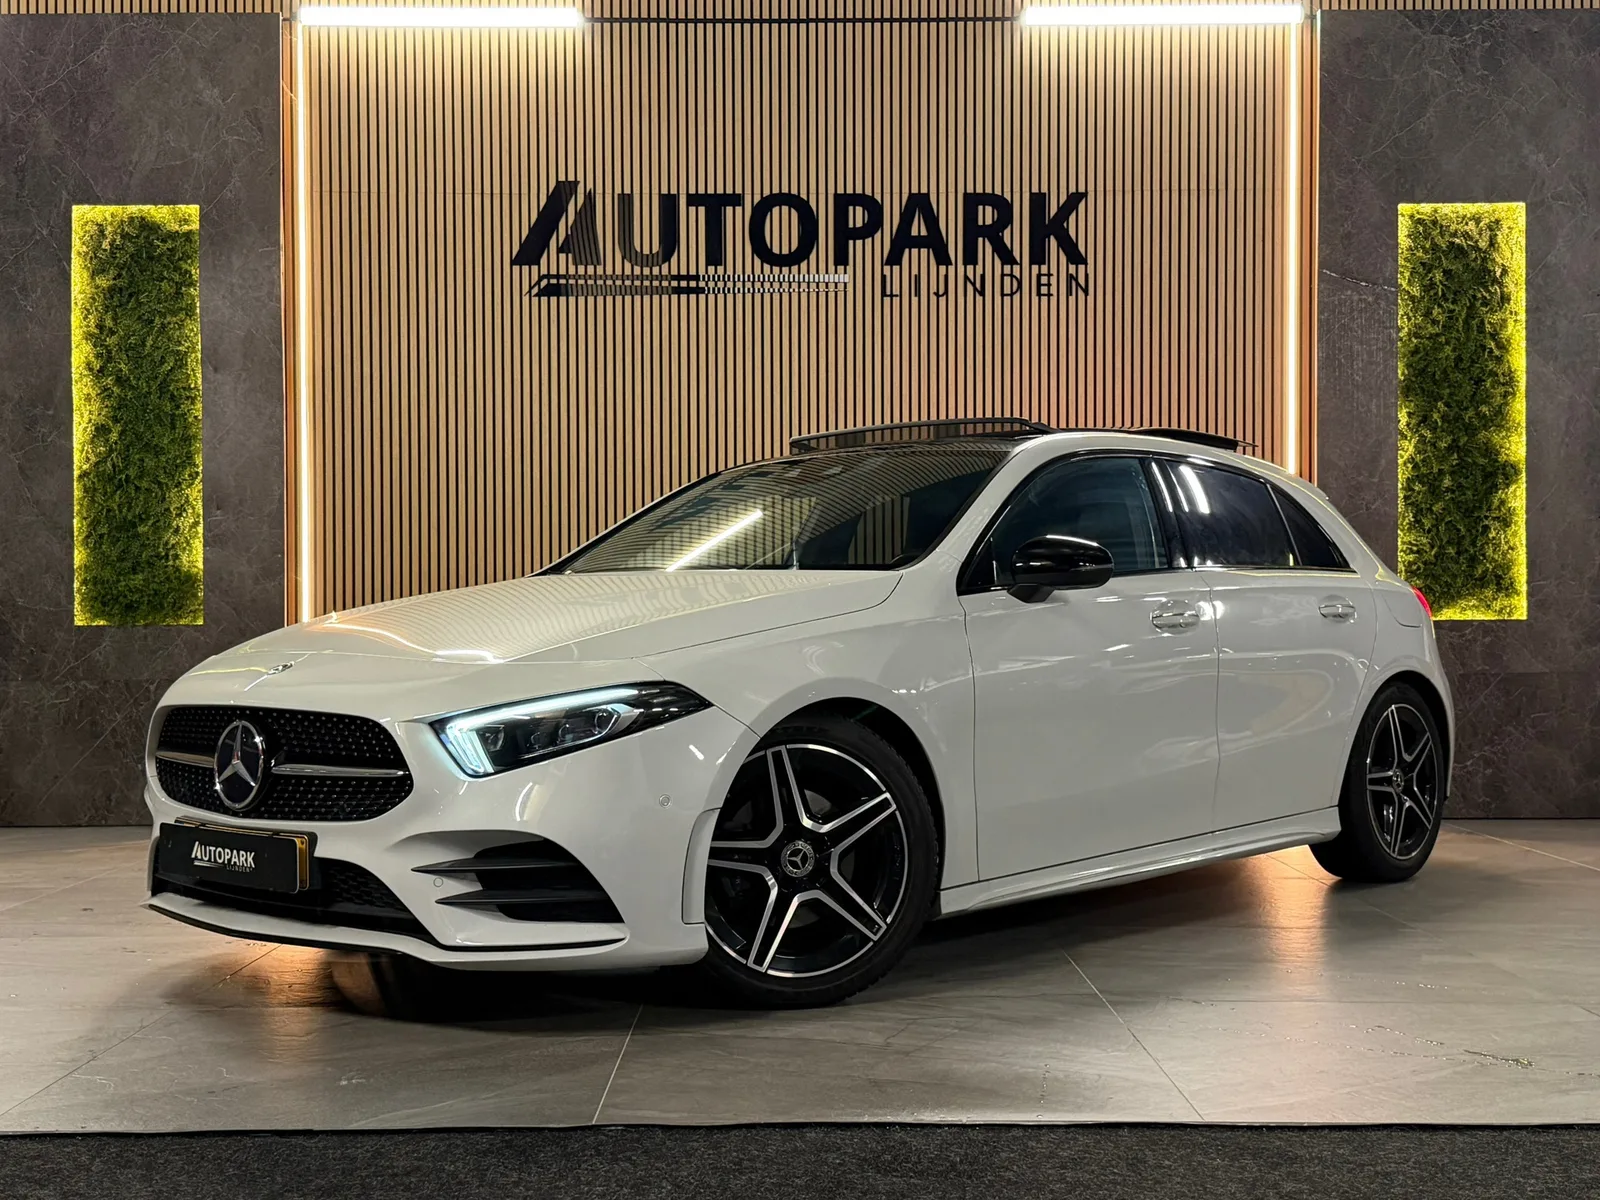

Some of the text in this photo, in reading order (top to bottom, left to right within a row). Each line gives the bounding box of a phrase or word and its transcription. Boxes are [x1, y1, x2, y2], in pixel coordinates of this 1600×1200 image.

[511, 180, 1088, 267] AUTOPARK
[882, 273, 1090, 298] LIJNDEN
[191, 841, 255, 868] AUTOPARK
